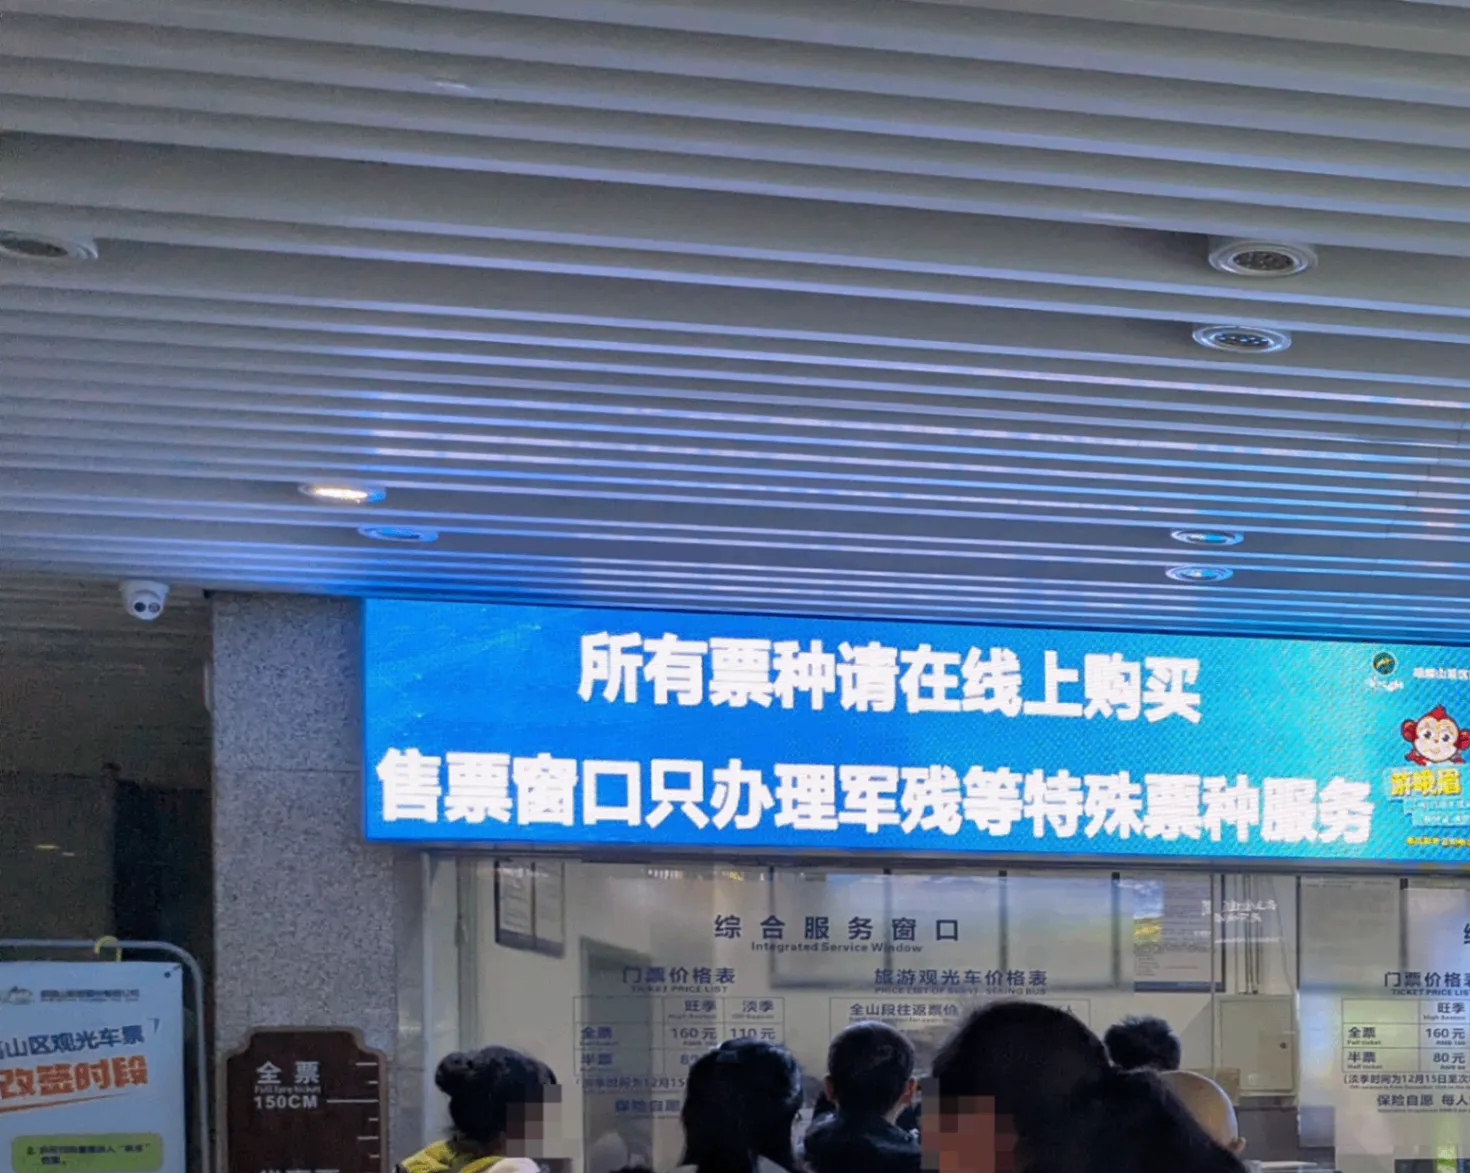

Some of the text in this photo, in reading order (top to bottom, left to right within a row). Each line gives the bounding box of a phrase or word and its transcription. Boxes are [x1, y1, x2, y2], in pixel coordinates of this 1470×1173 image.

[577, 631, 1201, 725] 所有票种请在线上购买
[376, 747, 1374, 846] 售票窗口只办理军残等特殊票种服务
[714, 915, 960, 942] 综合服务窗口
[751, 941, 922, 953] Integrated Service Window
[622, 966, 735, 985] 门票价格表
[874, 968, 1047, 986] 旅游观光车价格表
[671, 985, 702, 993] PRICE
[1391, 988, 1424, 996] TICKET
[1426, 988, 1452, 996] PRICE
[685, 1000, 774, 1012] 旺季 淡季
[850, 1003, 958, 1016] 全山段往返票价
[1437, 1003, 1465, 1014] 旺季
[1348, 1027, 1376, 1039] 全票
[0, 1025, 145, 1060] 山区观光车票
[1348, 1051, 1376, 1063] 半票
[256, 1061, 319, 1084] 全票
[254, 1095, 318, 1109] 150CM
[1377, 1094, 1433, 1106] 保险自愿
